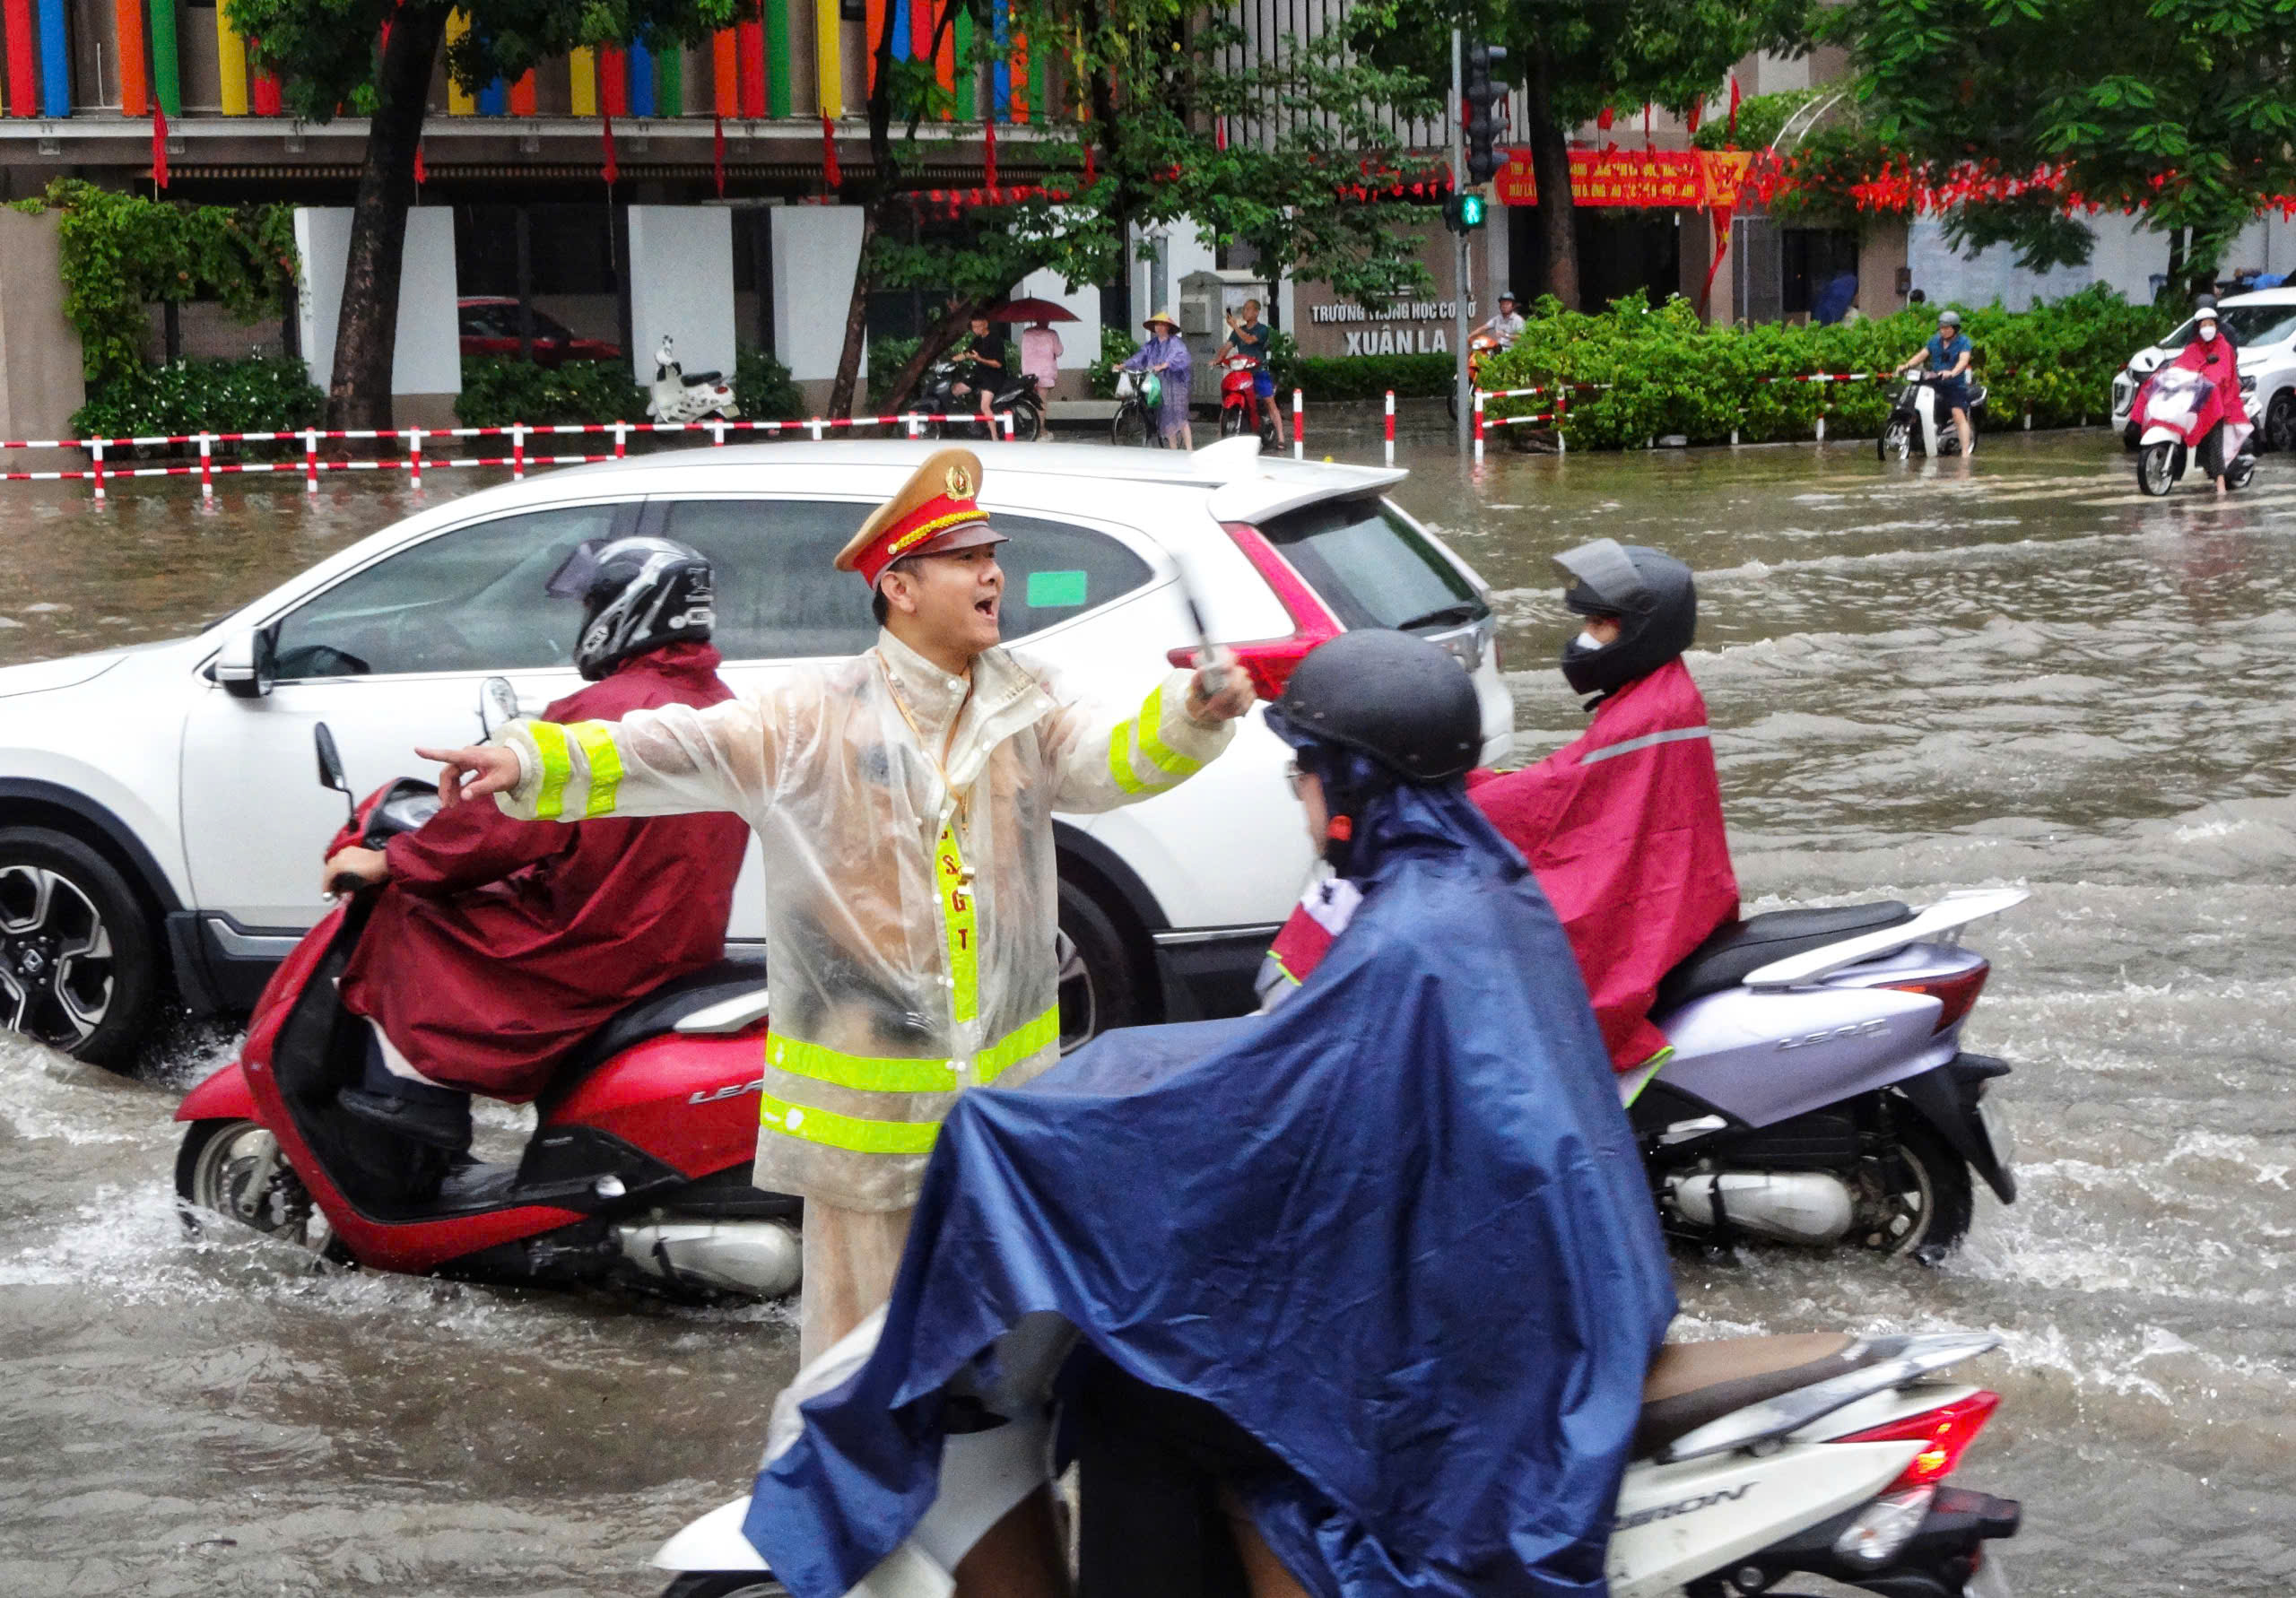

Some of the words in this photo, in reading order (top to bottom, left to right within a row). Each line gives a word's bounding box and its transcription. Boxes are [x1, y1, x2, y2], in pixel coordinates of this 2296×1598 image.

[1312, 300, 1365, 322] TRƯỜNG
[1412, 302, 1438, 324] HỌC
[1345, 324, 1413, 357] XUÂN
[1418, 328, 1448, 355] LA
[688, 1078, 764, 1105] LEA
